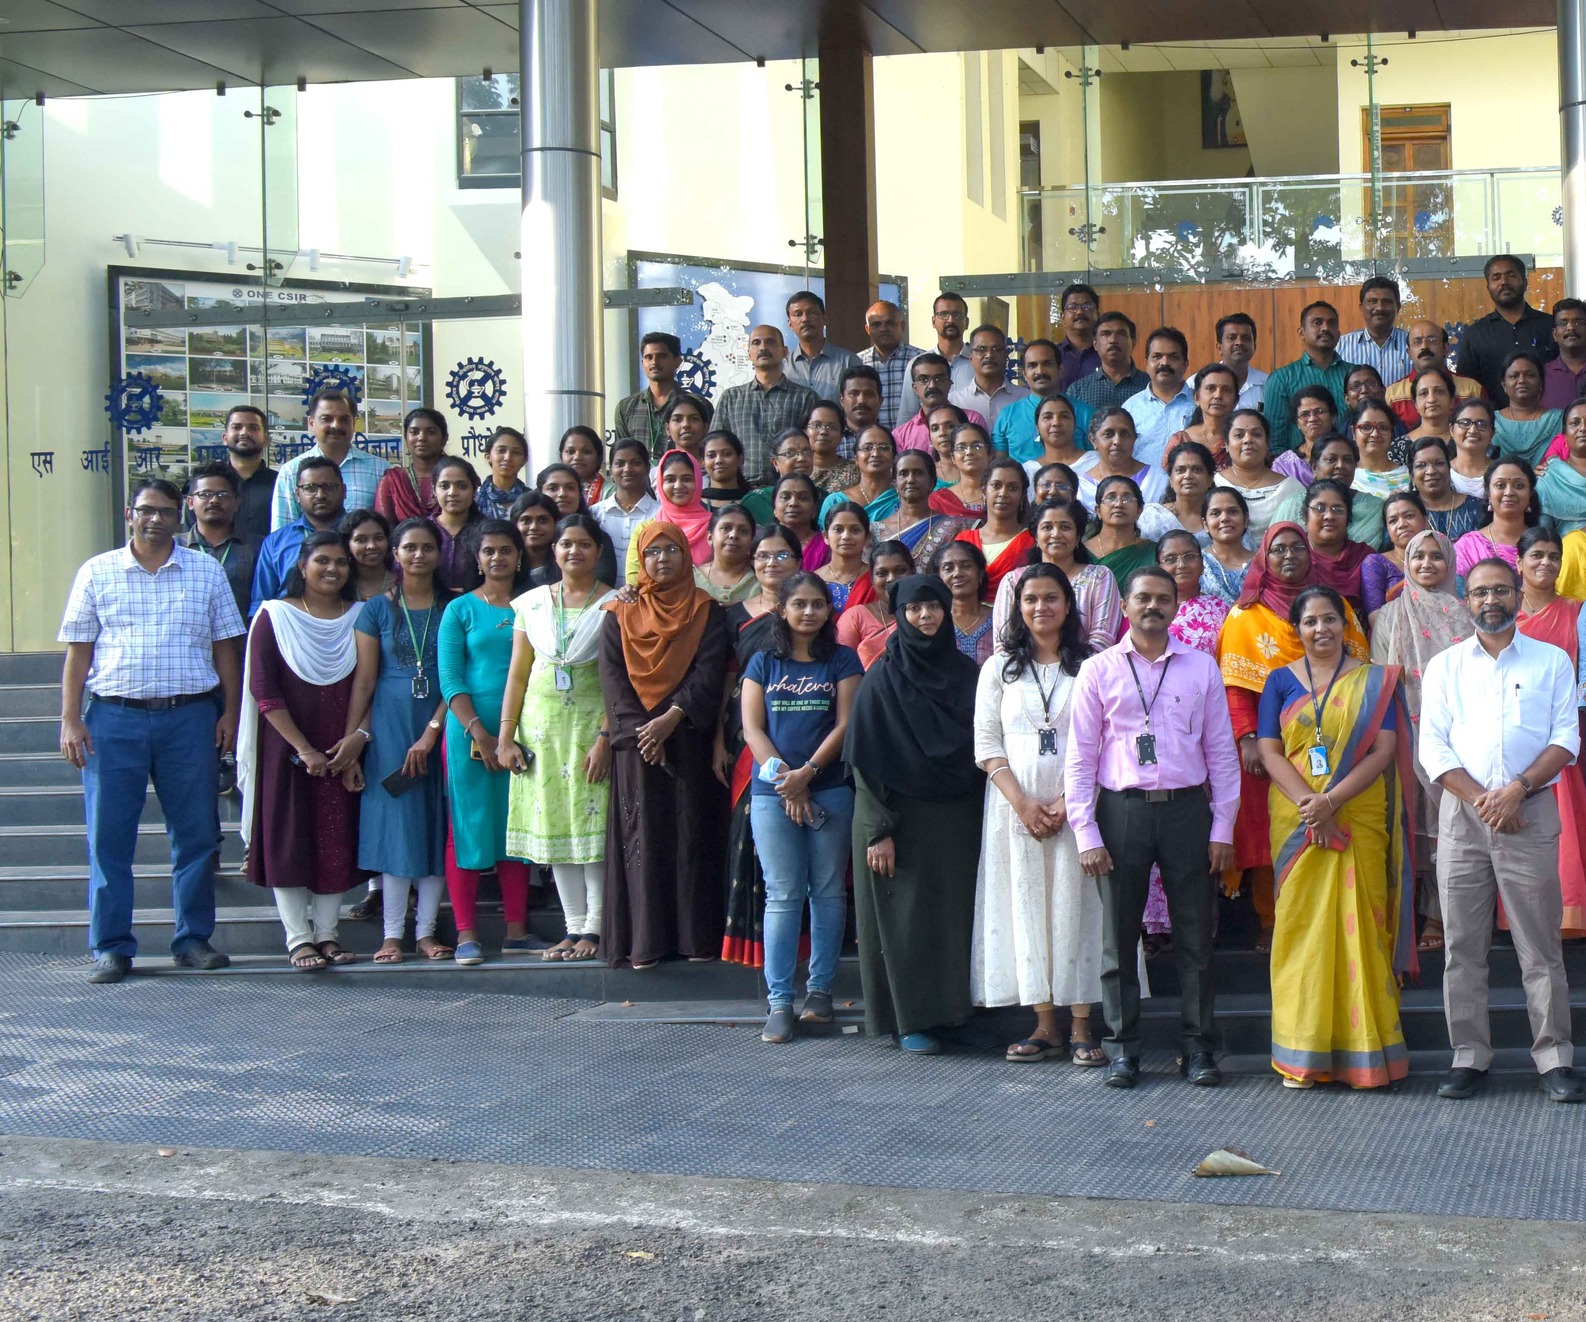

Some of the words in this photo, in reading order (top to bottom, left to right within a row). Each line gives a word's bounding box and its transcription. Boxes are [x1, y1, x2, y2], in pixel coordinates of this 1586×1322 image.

[247, 290, 273, 299] ONE
[278, 292, 307, 301] CSIR
[30, 452, 55, 478] एस
[80, 440, 111, 475] आई
[134, 447, 163, 471] आर
[766, 675, 836, 697] whatever
